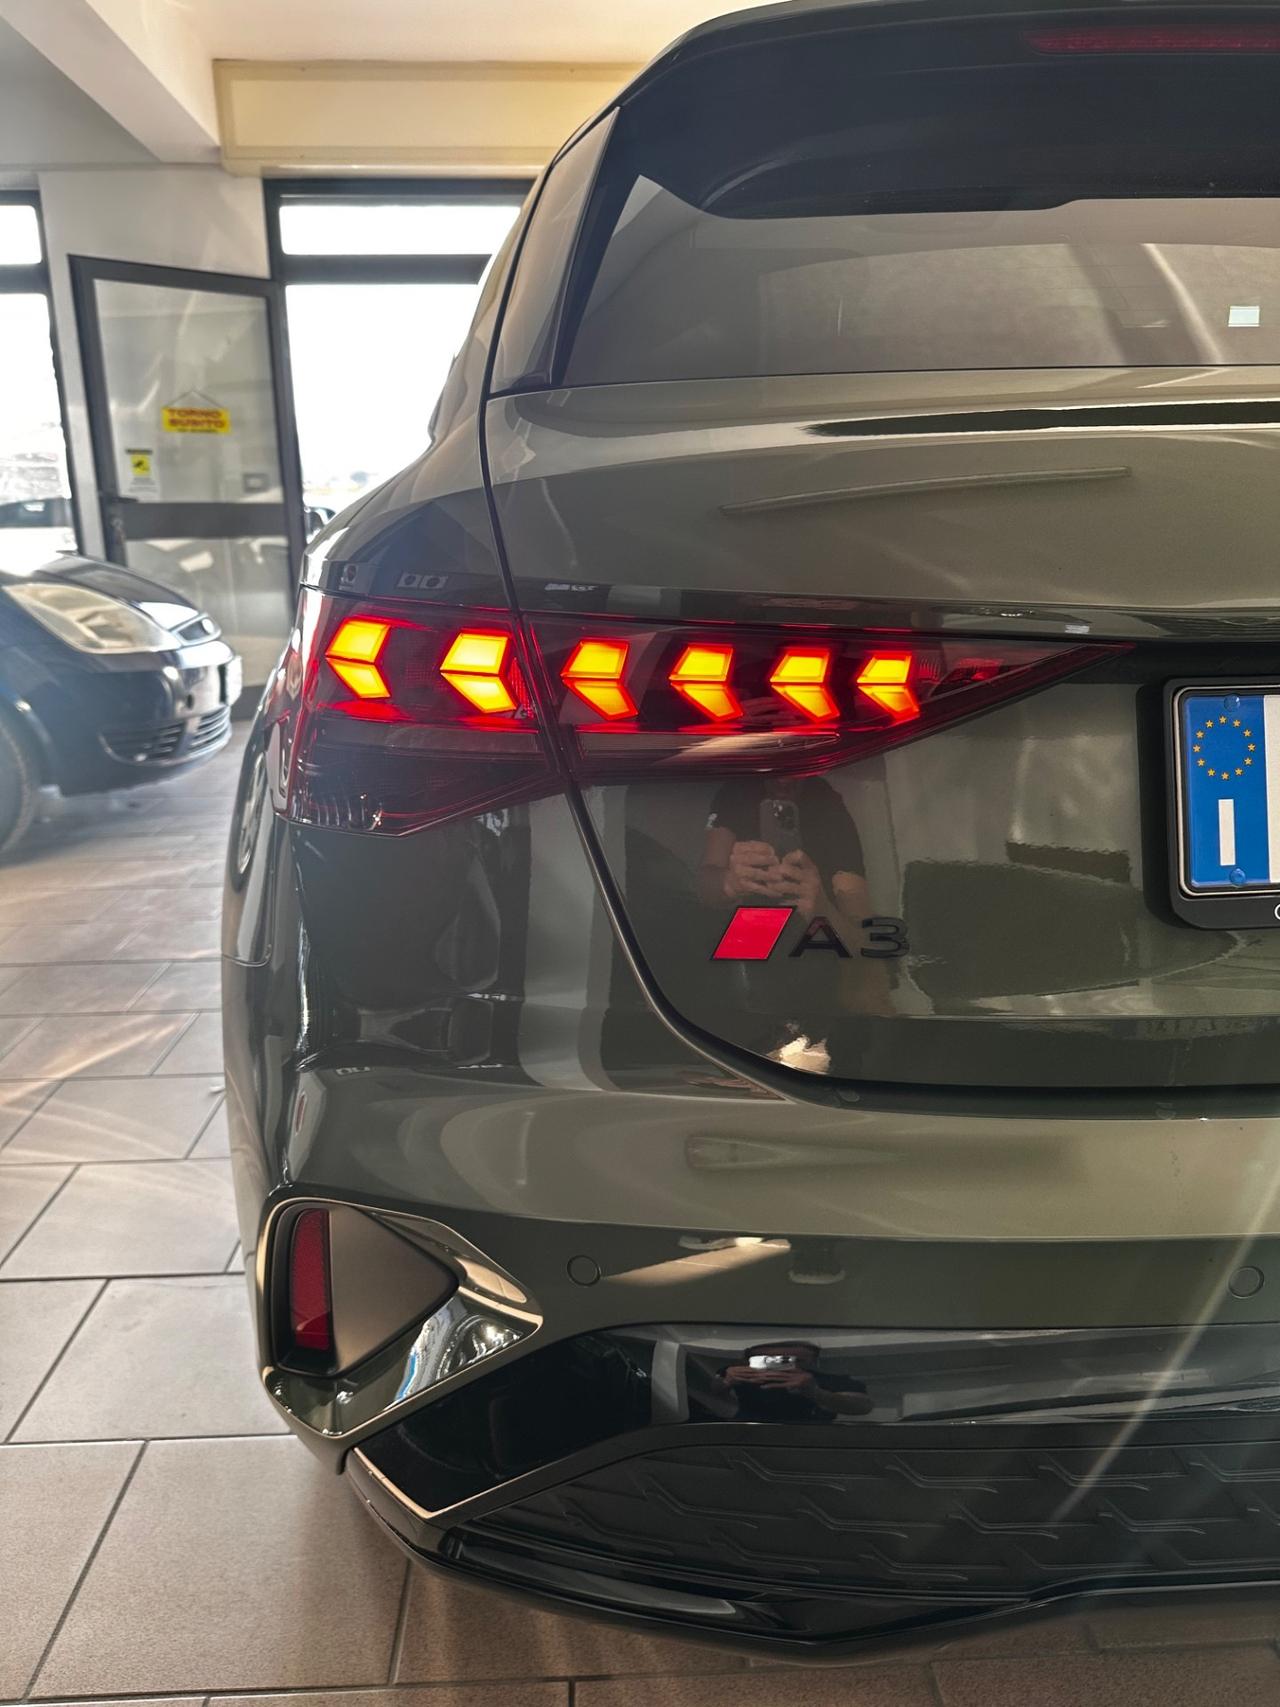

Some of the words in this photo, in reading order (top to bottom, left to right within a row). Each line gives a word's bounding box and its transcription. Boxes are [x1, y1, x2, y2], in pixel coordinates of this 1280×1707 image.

[168, 408, 221, 418] TORNO
[169, 418, 225, 428] SUBITO
[1218, 798, 1236, 866] I
[789, 915, 911, 958] A3
